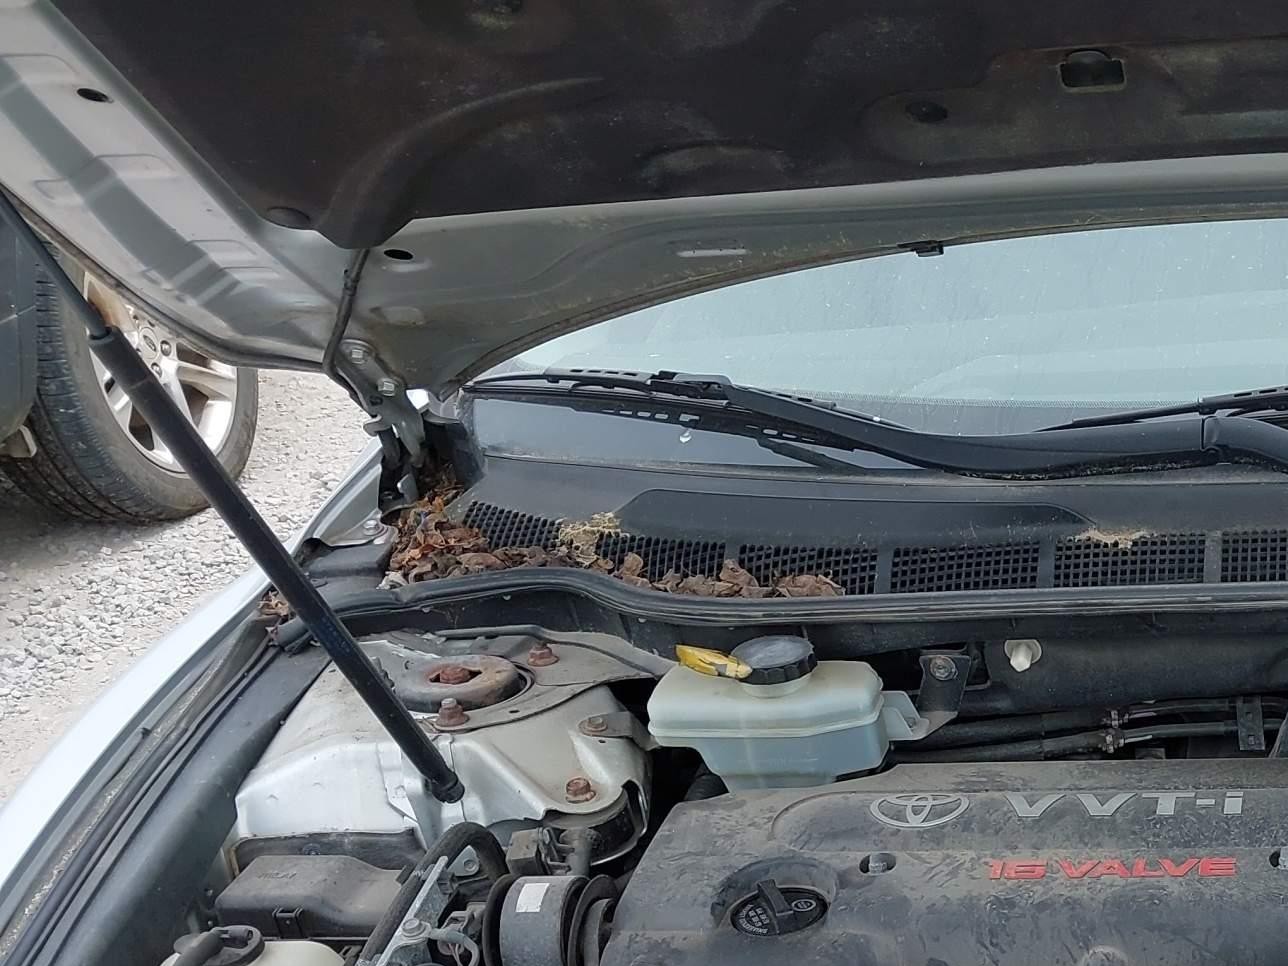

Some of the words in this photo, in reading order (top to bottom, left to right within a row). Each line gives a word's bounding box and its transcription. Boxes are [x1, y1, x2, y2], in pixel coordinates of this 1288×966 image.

[1005, 791, 1244, 817] VVT-i
[988, 857, 1047, 880] 16
[1056, 857, 1238, 879] VALVE
